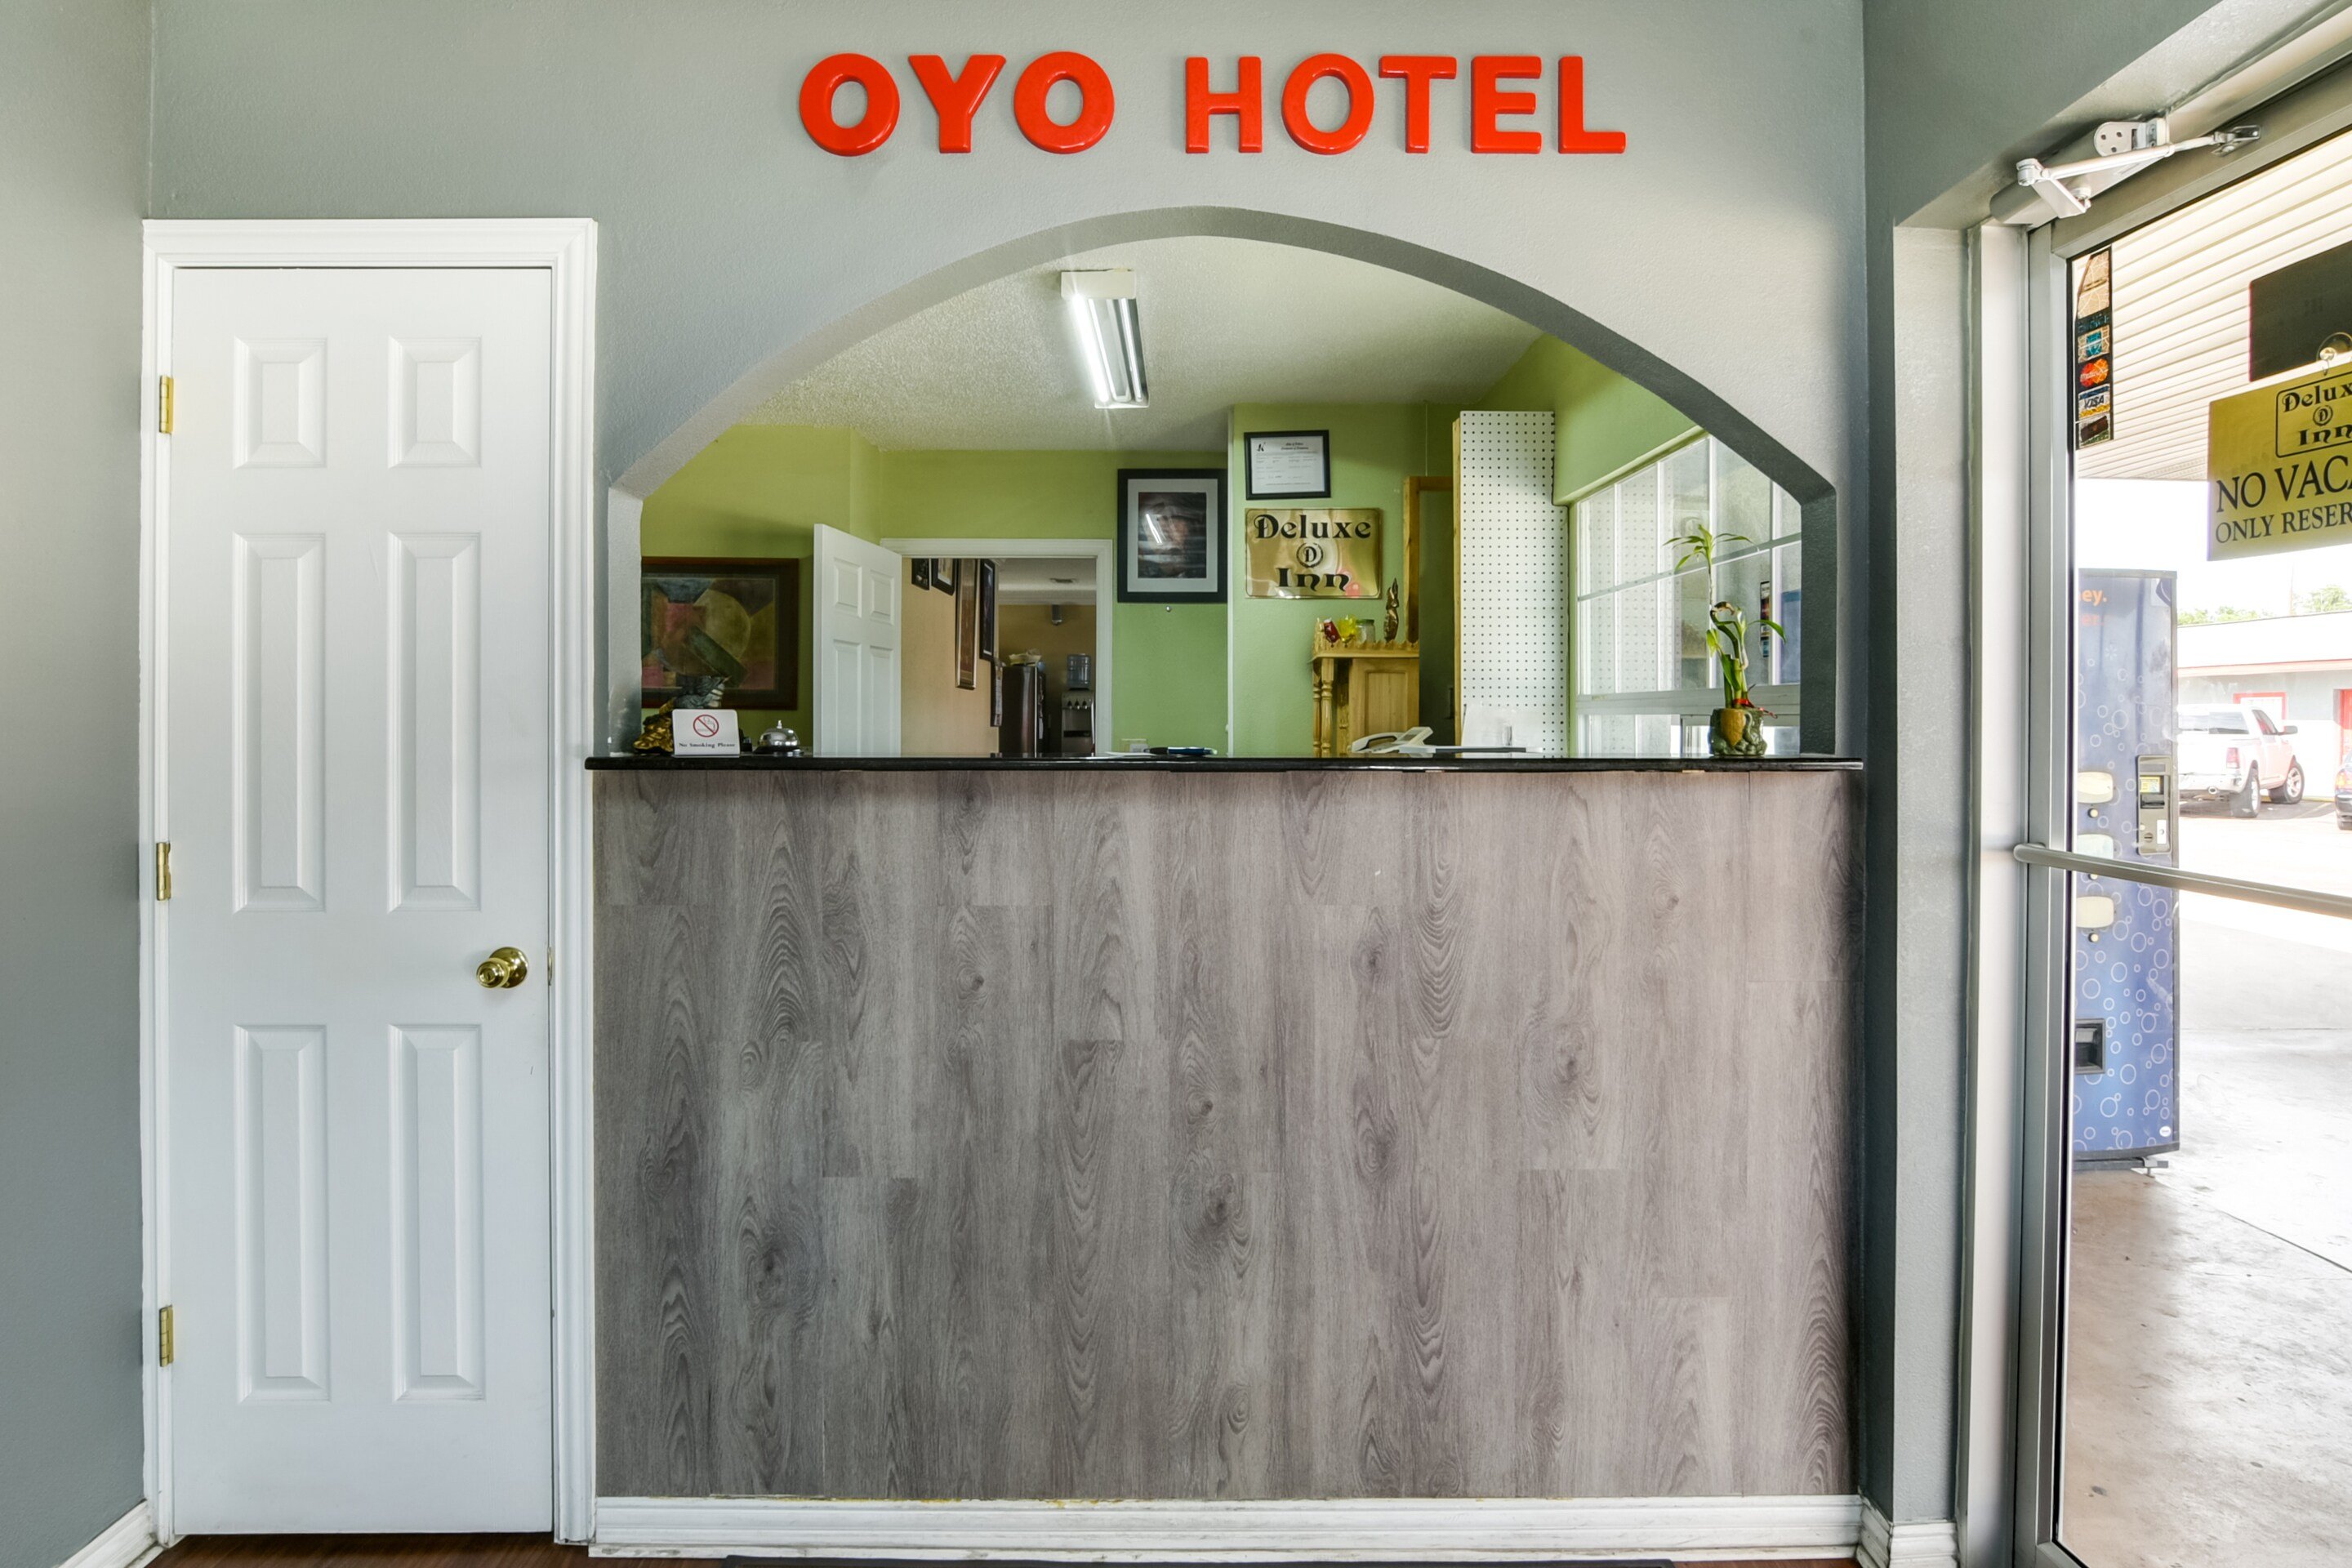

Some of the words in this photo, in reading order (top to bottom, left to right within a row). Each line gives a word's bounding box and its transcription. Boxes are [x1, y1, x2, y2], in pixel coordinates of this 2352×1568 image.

[799, 52, 1116, 157] OYO
[1185, 52, 1627, 155] HOTEL
[2084, 395, 2105, 409] VISA
[2299, 425, 2352, 446] Inn
[2216, 471, 2266, 513] NO
[2274, 455, 2352, 501] VAC
[1253, 514, 1372, 539] Deluxe
[2215, 514, 2274, 543] ONLY
[2281, 501, 2352, 534] RESER
[1276, 568, 1350, 592] Inn
